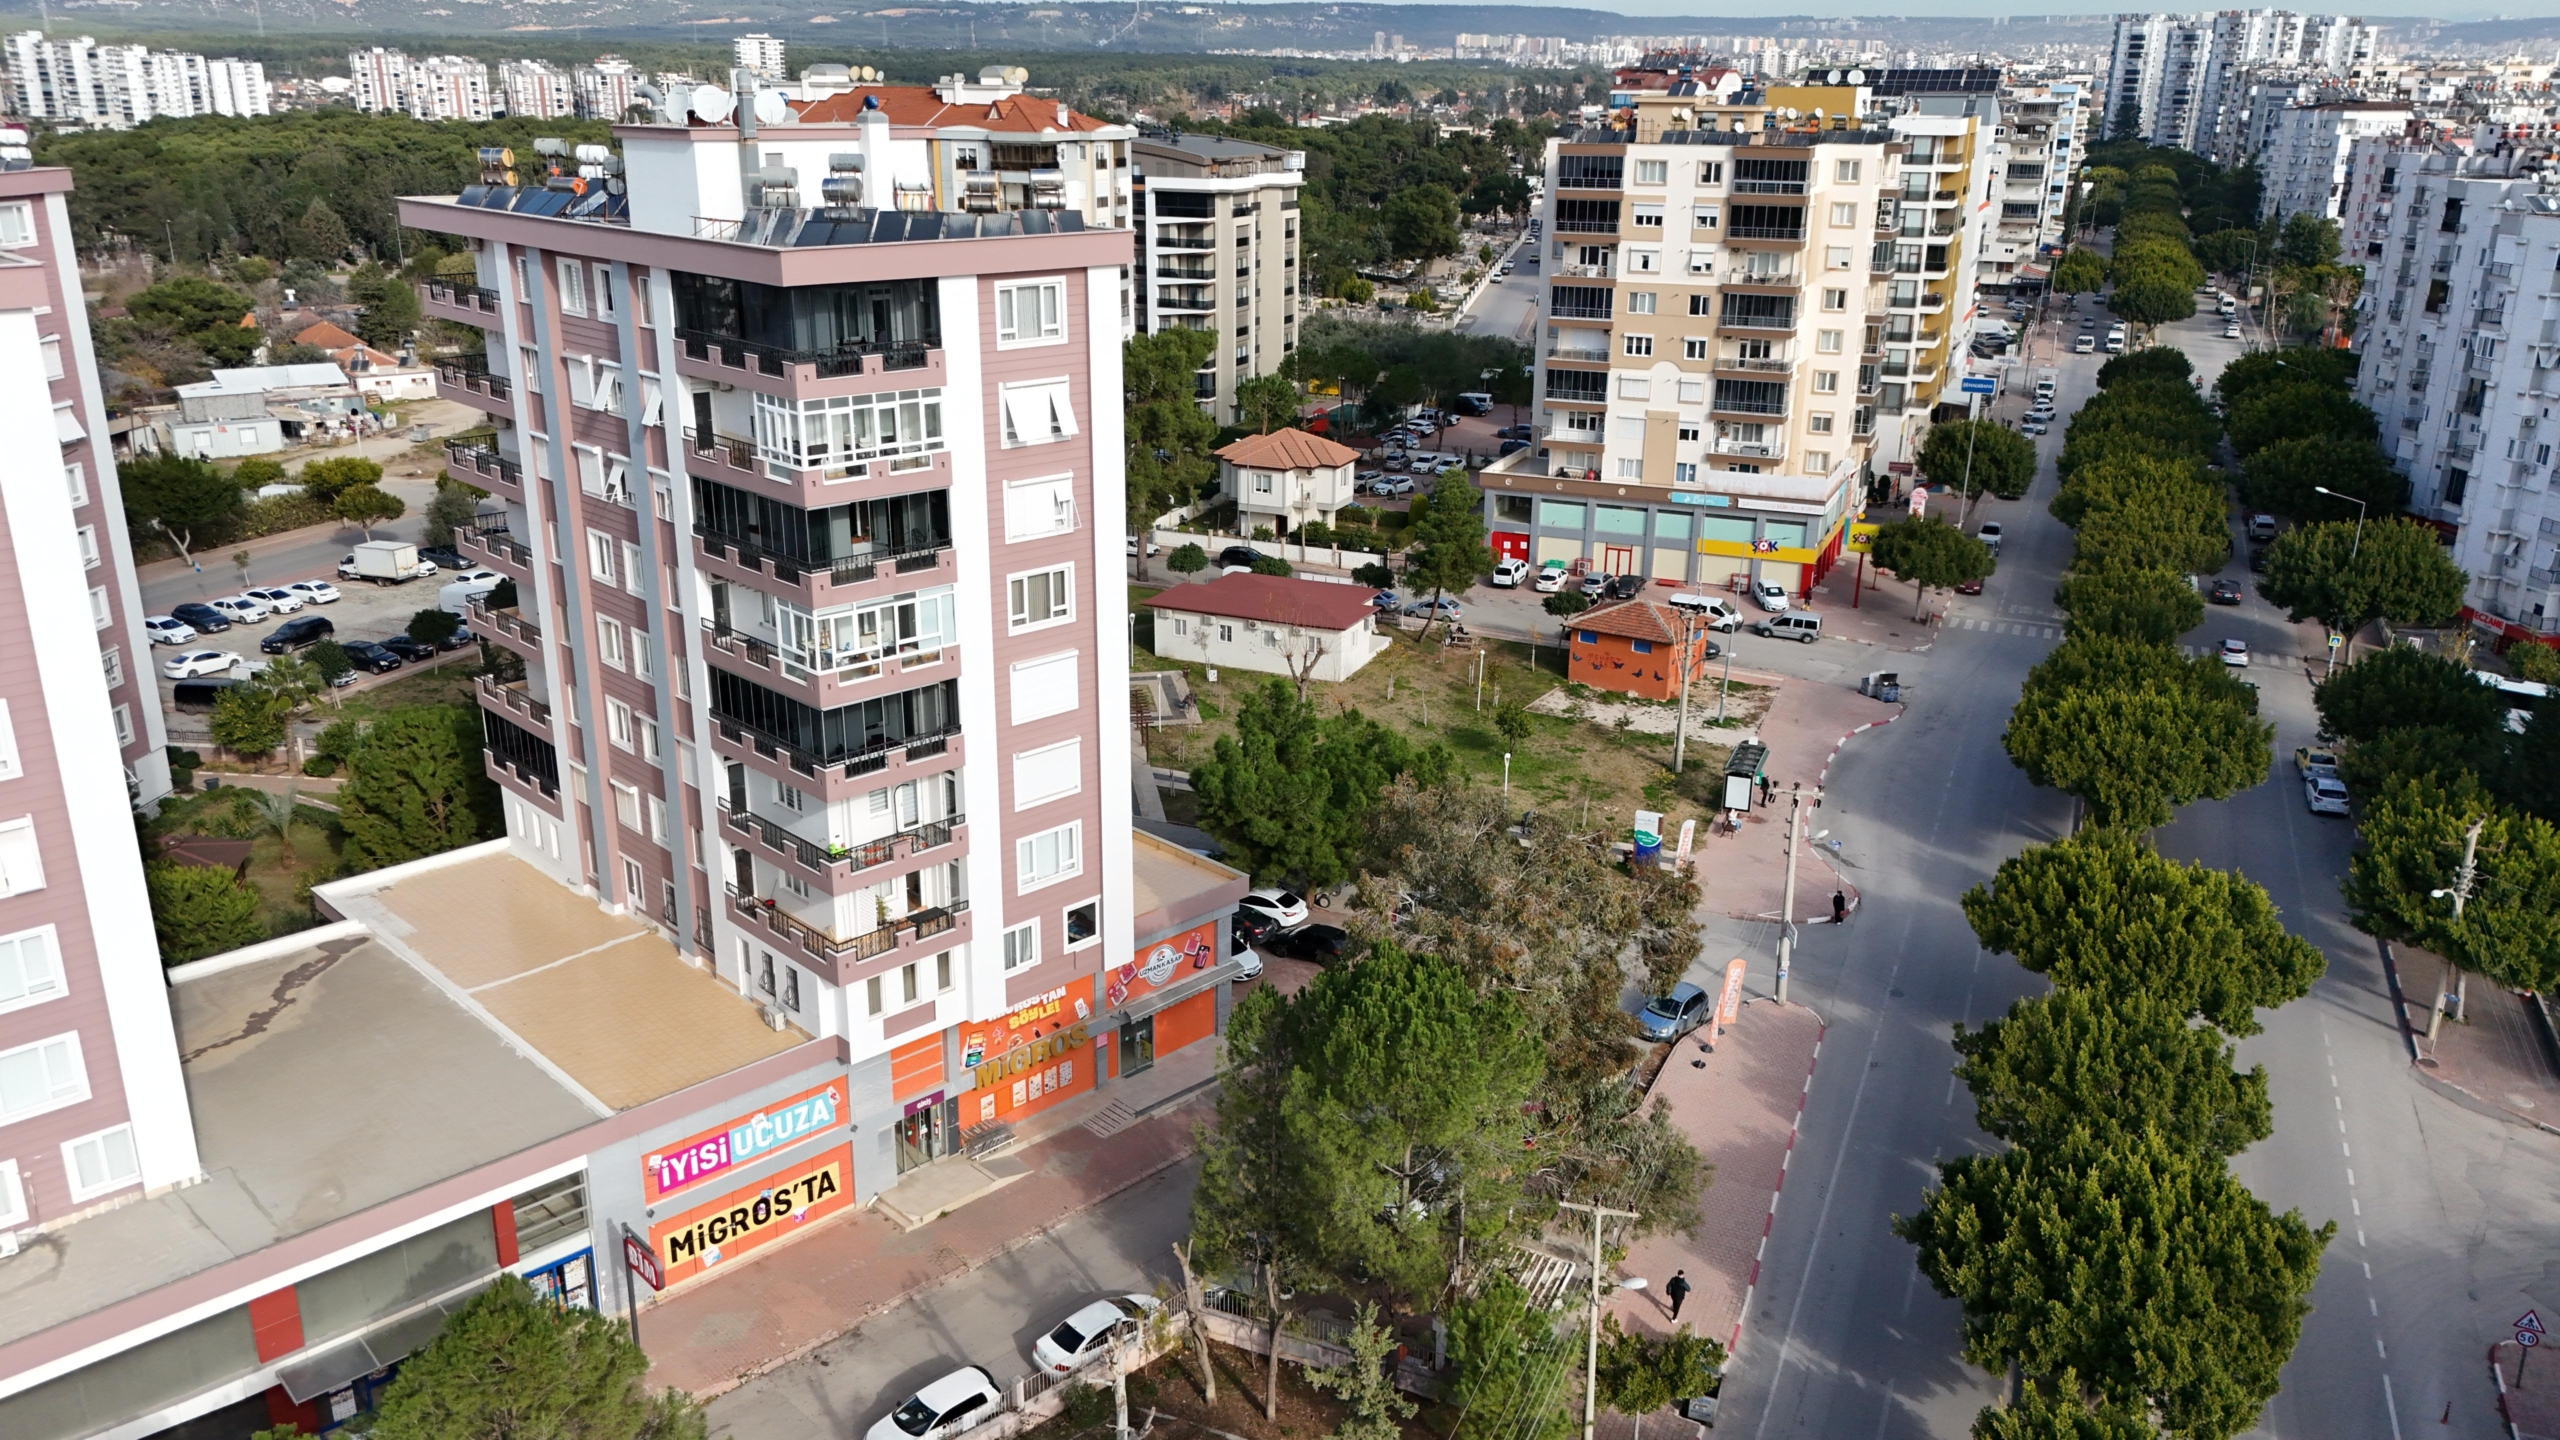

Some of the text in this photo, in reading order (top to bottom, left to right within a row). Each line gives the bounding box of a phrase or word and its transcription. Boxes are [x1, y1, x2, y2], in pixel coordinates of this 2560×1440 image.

[1752, 539, 1779, 555] ŞOK
[2474, 610, 2505, 631] ECZANE
[1008, 999, 1061, 1030] SÖYLE!
[733, 1098, 830, 1157] UCUZA
[2519, 1333, 2535, 1344] 50
